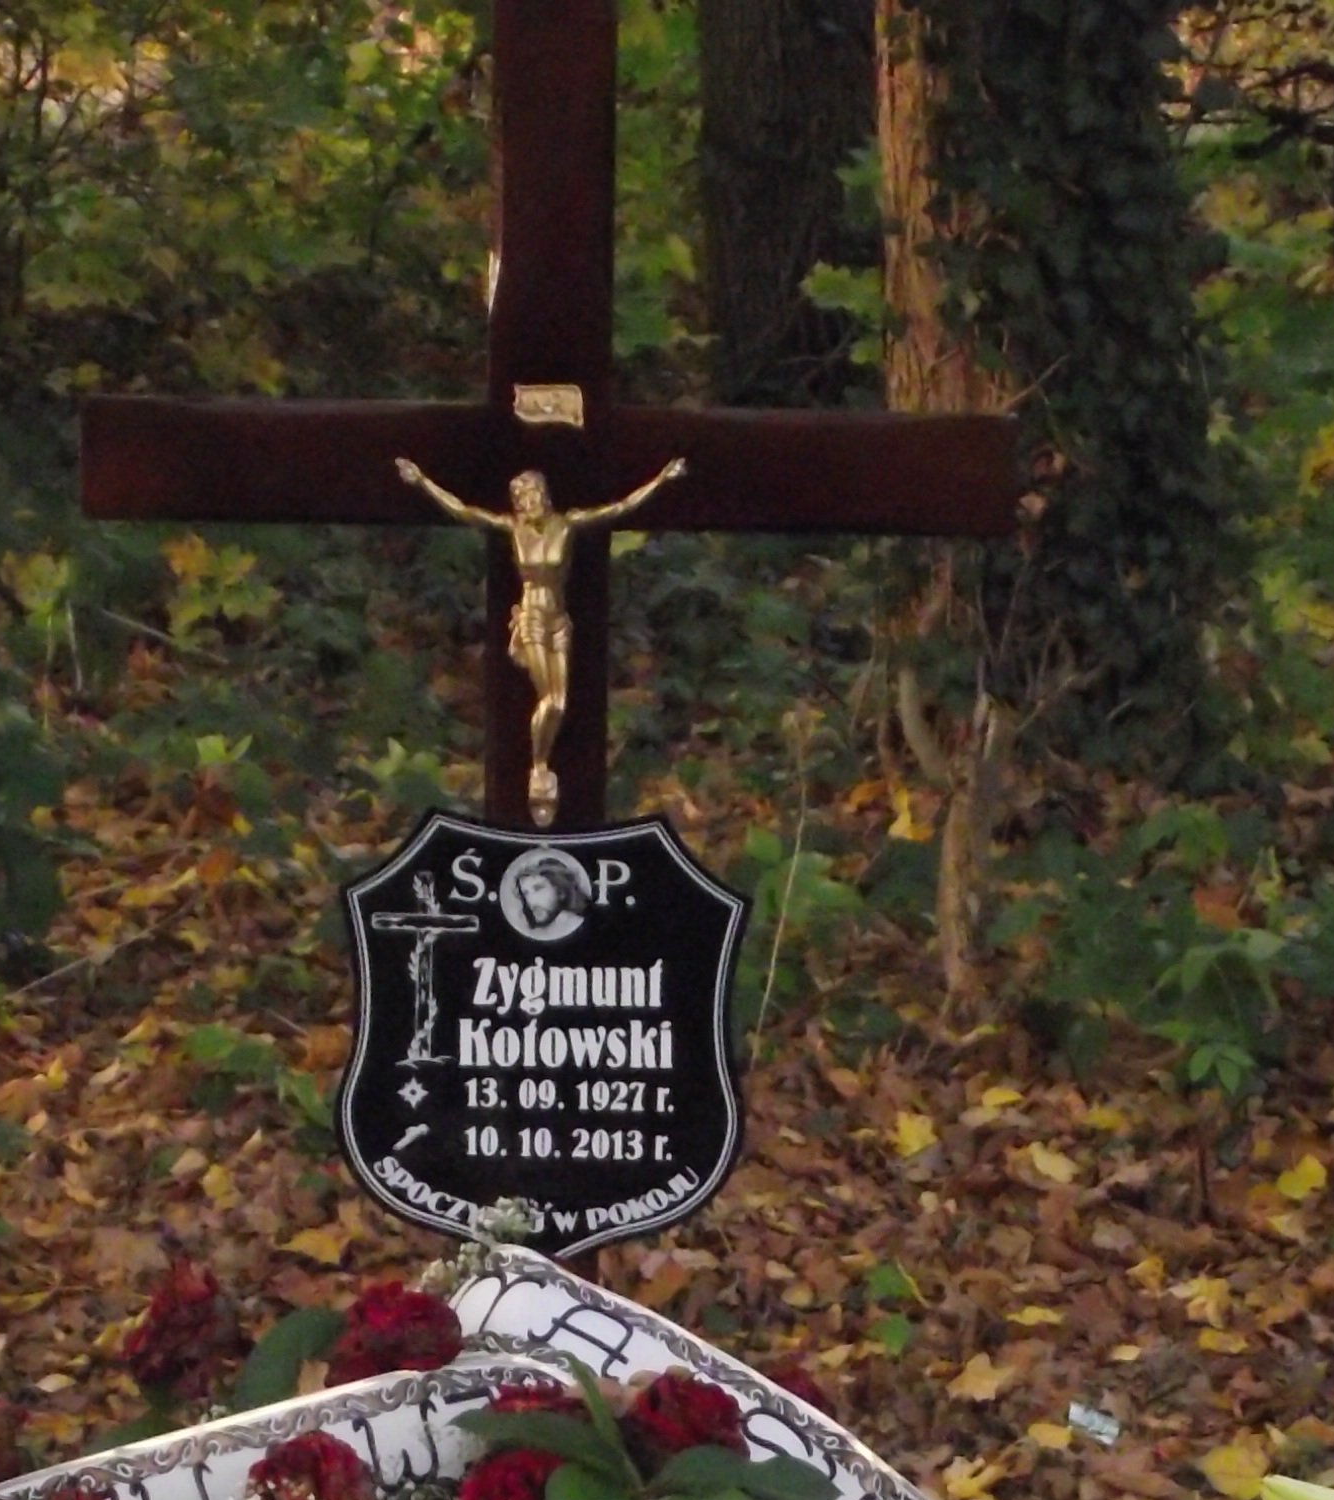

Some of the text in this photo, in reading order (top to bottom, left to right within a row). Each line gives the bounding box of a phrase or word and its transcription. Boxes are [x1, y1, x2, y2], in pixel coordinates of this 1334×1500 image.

[449, 847, 636, 906] Ś. P.
[472, 956, 664, 1015] Zygmunt
[464, 1077, 675, 1113] 13. 09. 1927 r.
[463, 1125, 673, 1161] 10. 10. 2013 r.
[373, 1155, 700, 1234] SPOCZYJ W POKOJU
